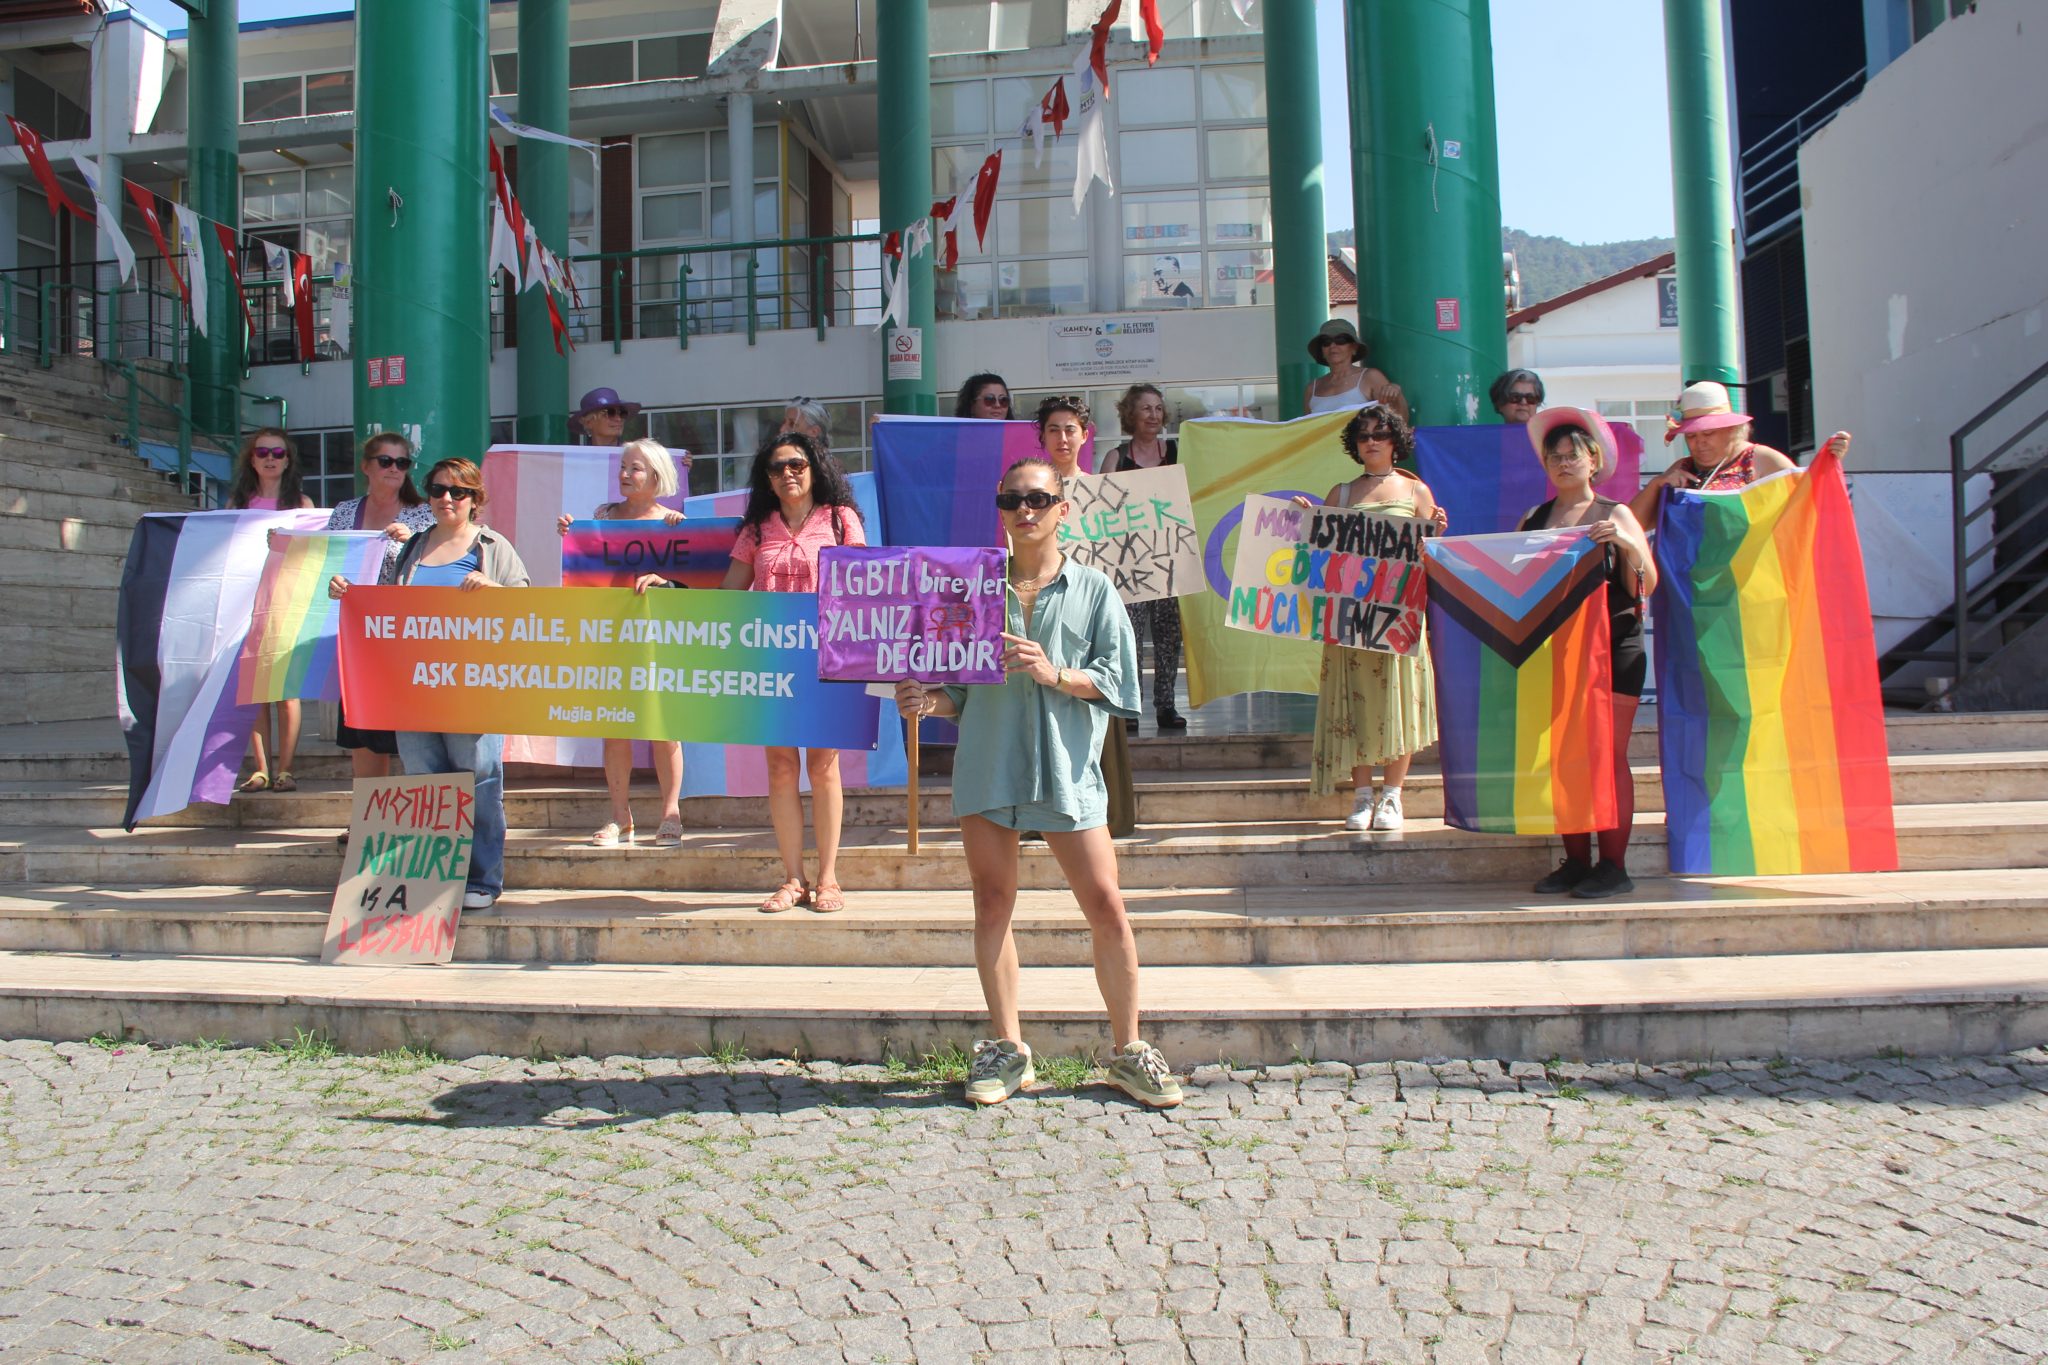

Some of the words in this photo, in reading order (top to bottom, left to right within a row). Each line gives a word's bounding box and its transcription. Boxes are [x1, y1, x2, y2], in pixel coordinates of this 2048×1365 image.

[1217, 266, 1253, 279] CLUB
[1063, 325, 1089, 333] KAHEV
[1254, 506, 1304, 542] MOR
[603, 539, 690, 567] LOVE
[1058, 540, 1114, 567] OR
[1112, 522, 1197, 566] YOUR
[831, 553, 910, 597] LGBTİ
[919, 561, 1007, 602] bireyler
[365, 615, 396, 639] NE
[402, 616, 504, 643] ATANMIŞ
[510, 613, 571, 646] AİLE,
[579, 618, 614, 643] NE
[618, 619, 732, 649] ATANMIŞ
[825, 605, 912, 642] YALNIZ
[876, 633, 997, 675] DEĞİLDİR
[412, 661, 458, 688] AŞK
[464, 663, 622, 691] BAŞKALDIRIR
[630, 661, 795, 698] BİRLEŞEREK
[549, 704, 592, 723] Muğla
[596, 706, 636, 722] Pride
[363, 784, 474, 831] MOTHER
[357, 831, 473, 882] NATURE
[360, 886, 382, 911] IS
[385, 884, 408, 911] A
[337, 907, 460, 957] LESBIAN
